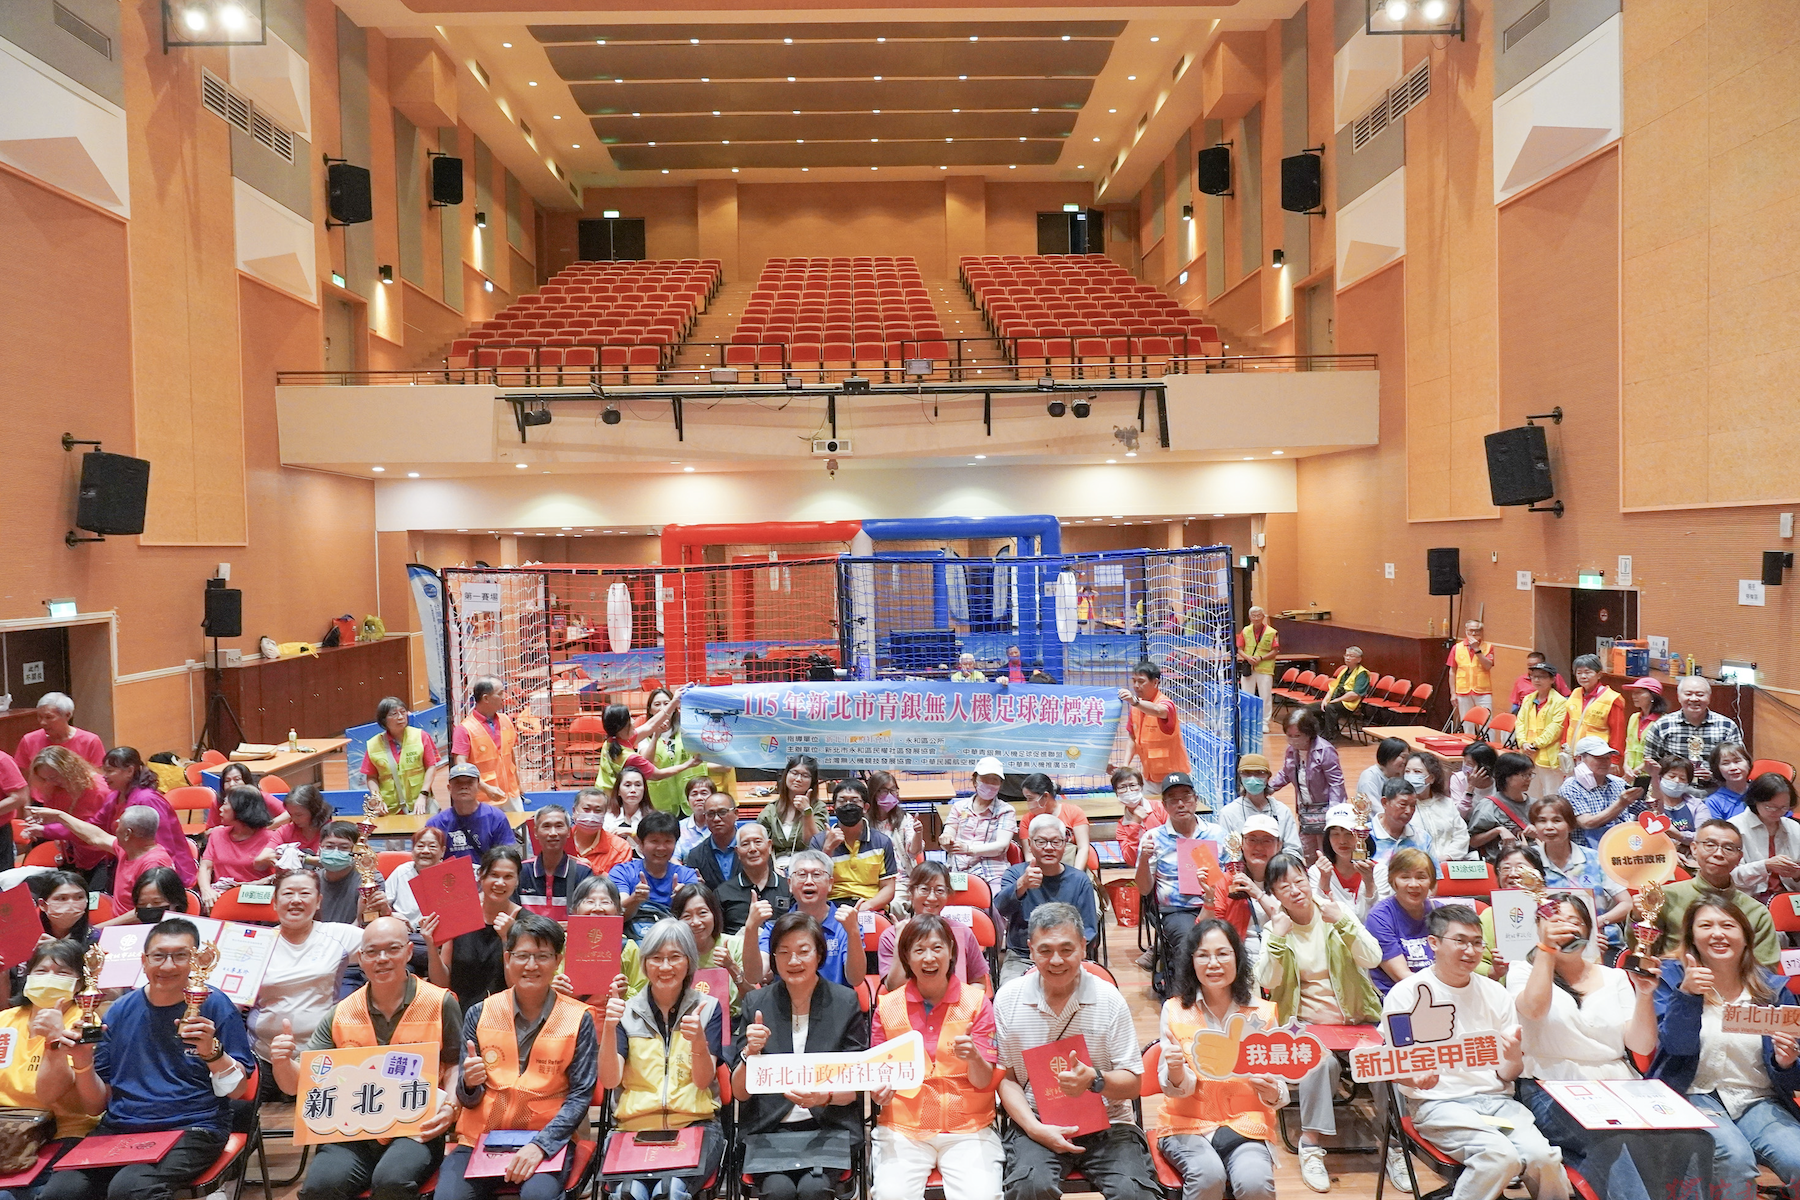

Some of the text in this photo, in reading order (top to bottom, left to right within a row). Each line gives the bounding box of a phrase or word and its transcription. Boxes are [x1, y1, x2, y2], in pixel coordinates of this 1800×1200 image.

[464, 591, 498, 601] 第一賽場
[744, 690, 1105, 727] 115年新北市青銀無人機足球錦標賽
[1611, 854, 1666, 866] 新北市政府
[1246, 1043, 1312, 1065] 我最棒
[1354, 1035, 1500, 1078] 新北金甲讚
[755, 1062, 915, 1087] 新北市政府社會局
[303, 1080, 430, 1118] 新北市
